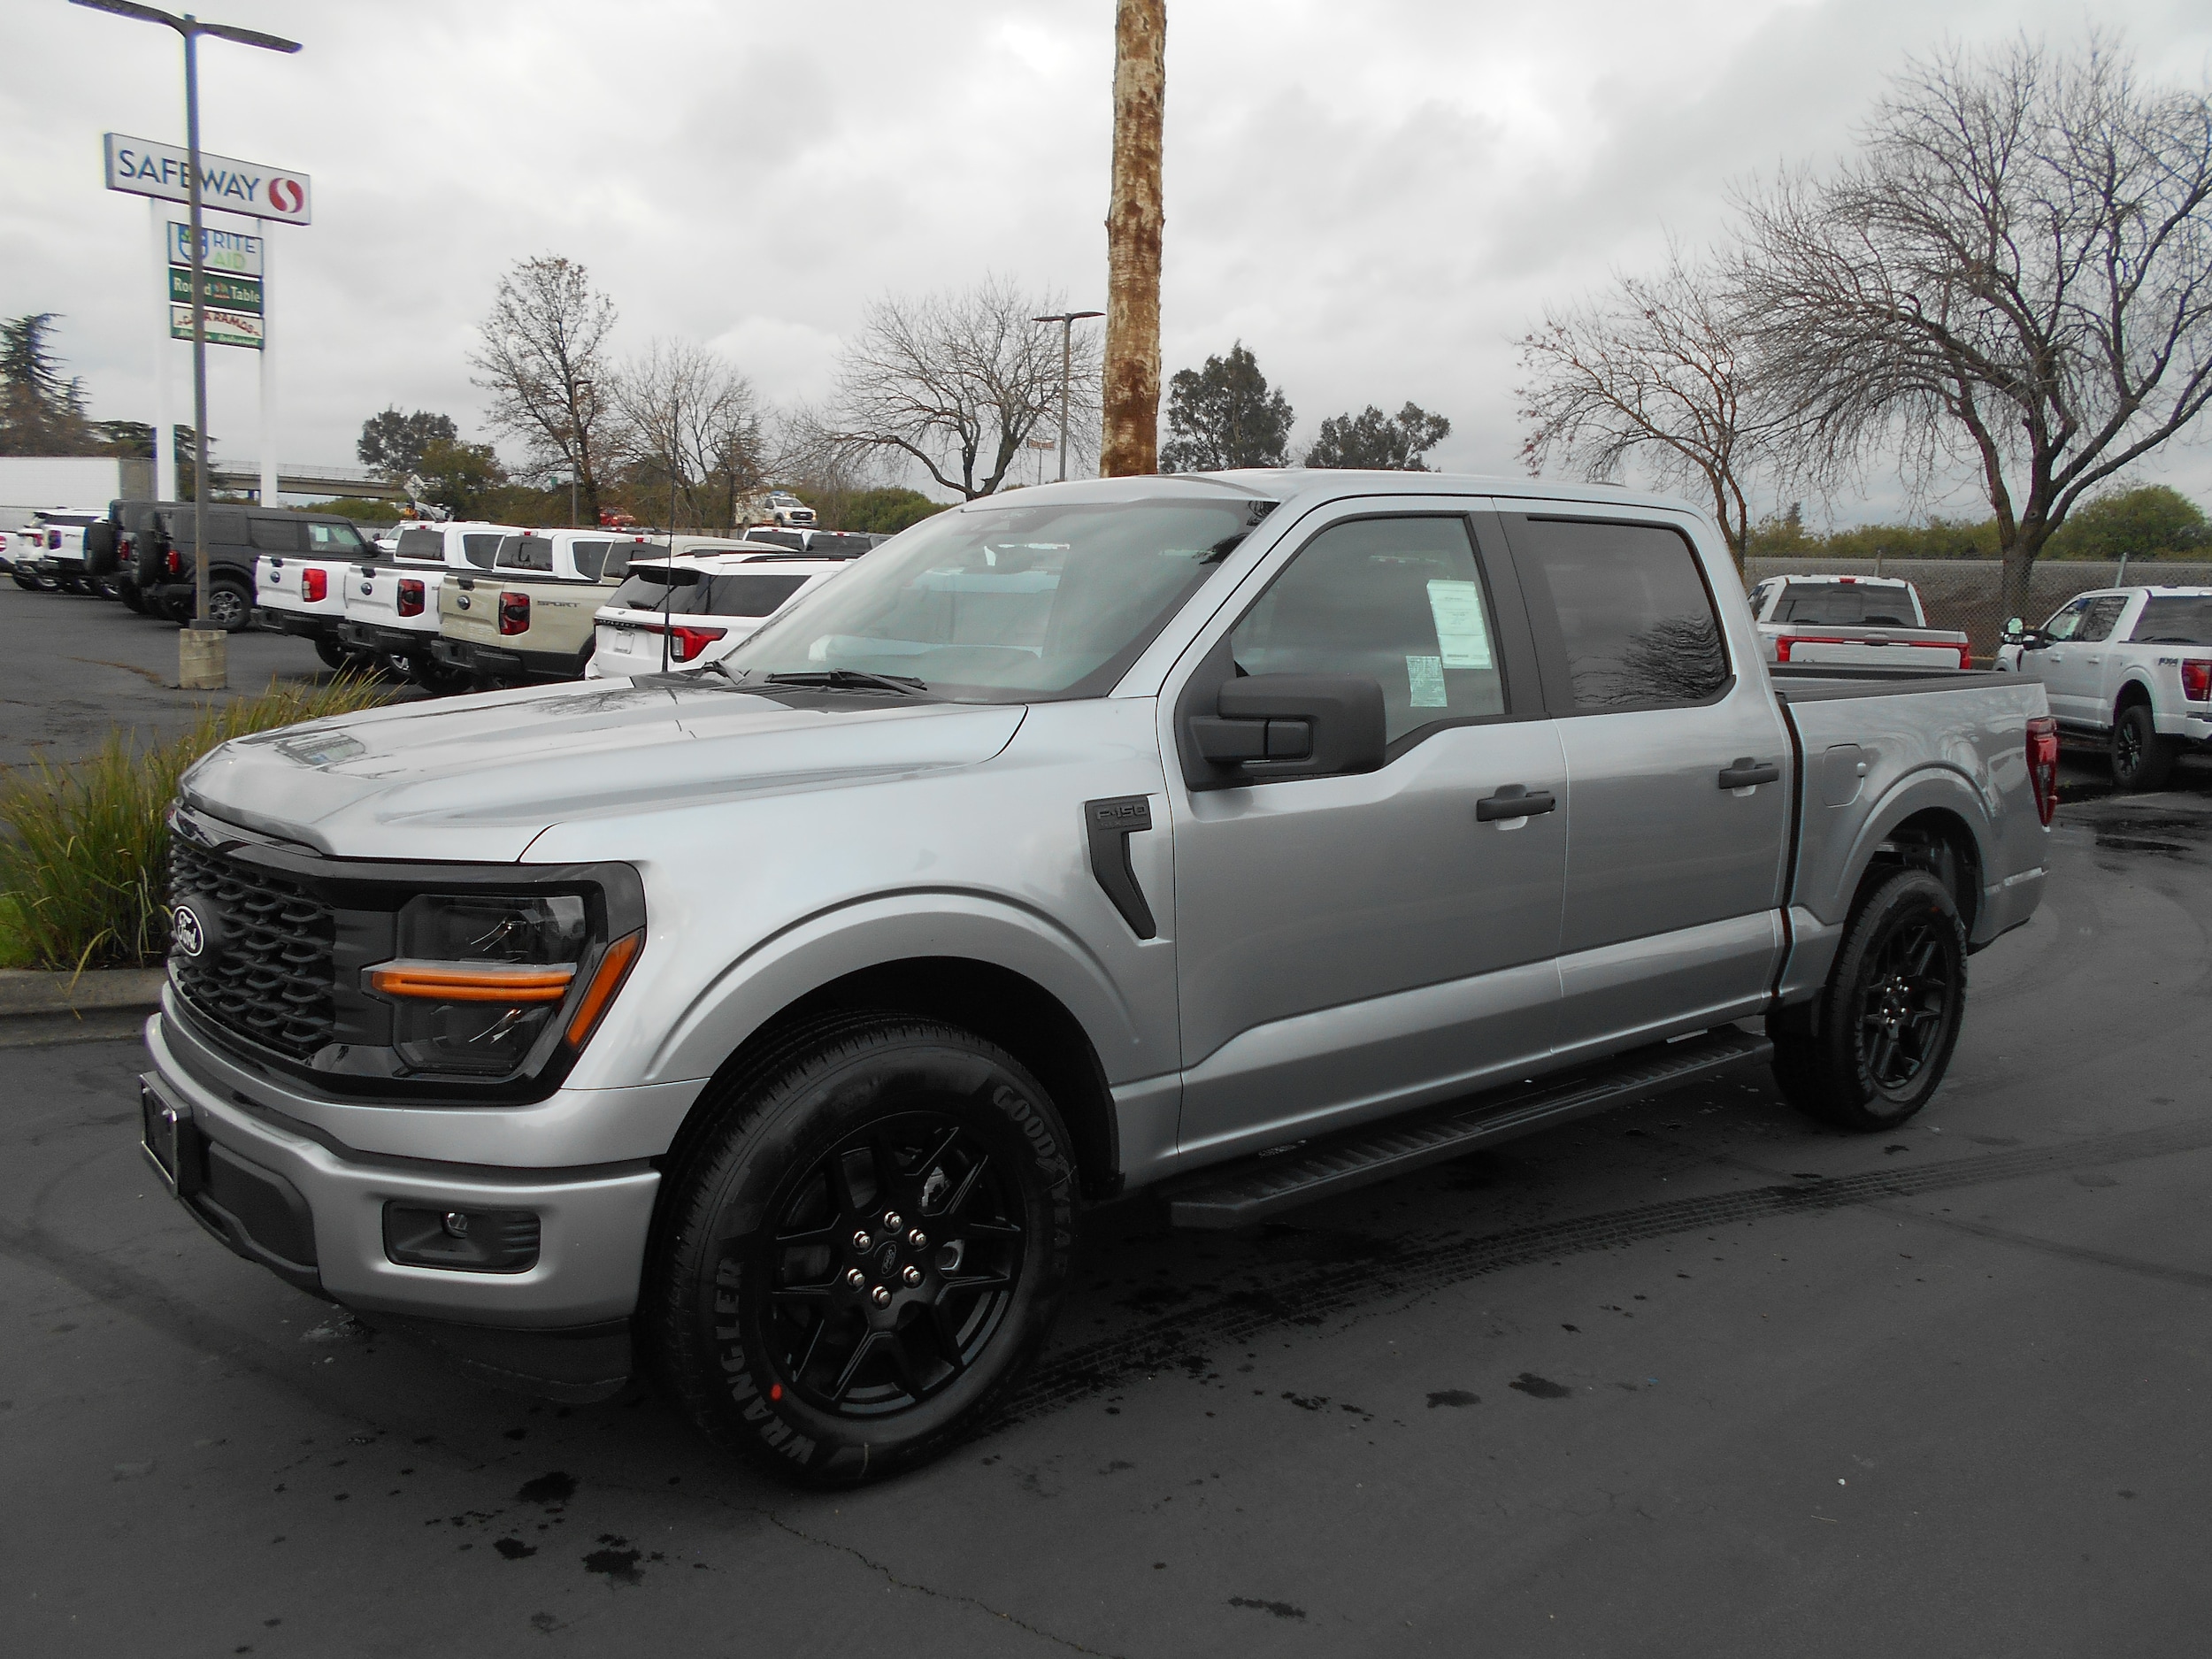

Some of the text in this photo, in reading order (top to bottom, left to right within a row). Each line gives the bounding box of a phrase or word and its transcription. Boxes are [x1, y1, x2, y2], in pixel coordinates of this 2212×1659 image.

[119, 149, 260, 202] SAFEWAY
[213, 230, 256, 254] RITE
[213, 250, 246, 270] AID
[230, 286, 261, 303] Table
[1096, 804, 1148, 821] F-150
[714, 1257, 817, 1464] WRANGLER
